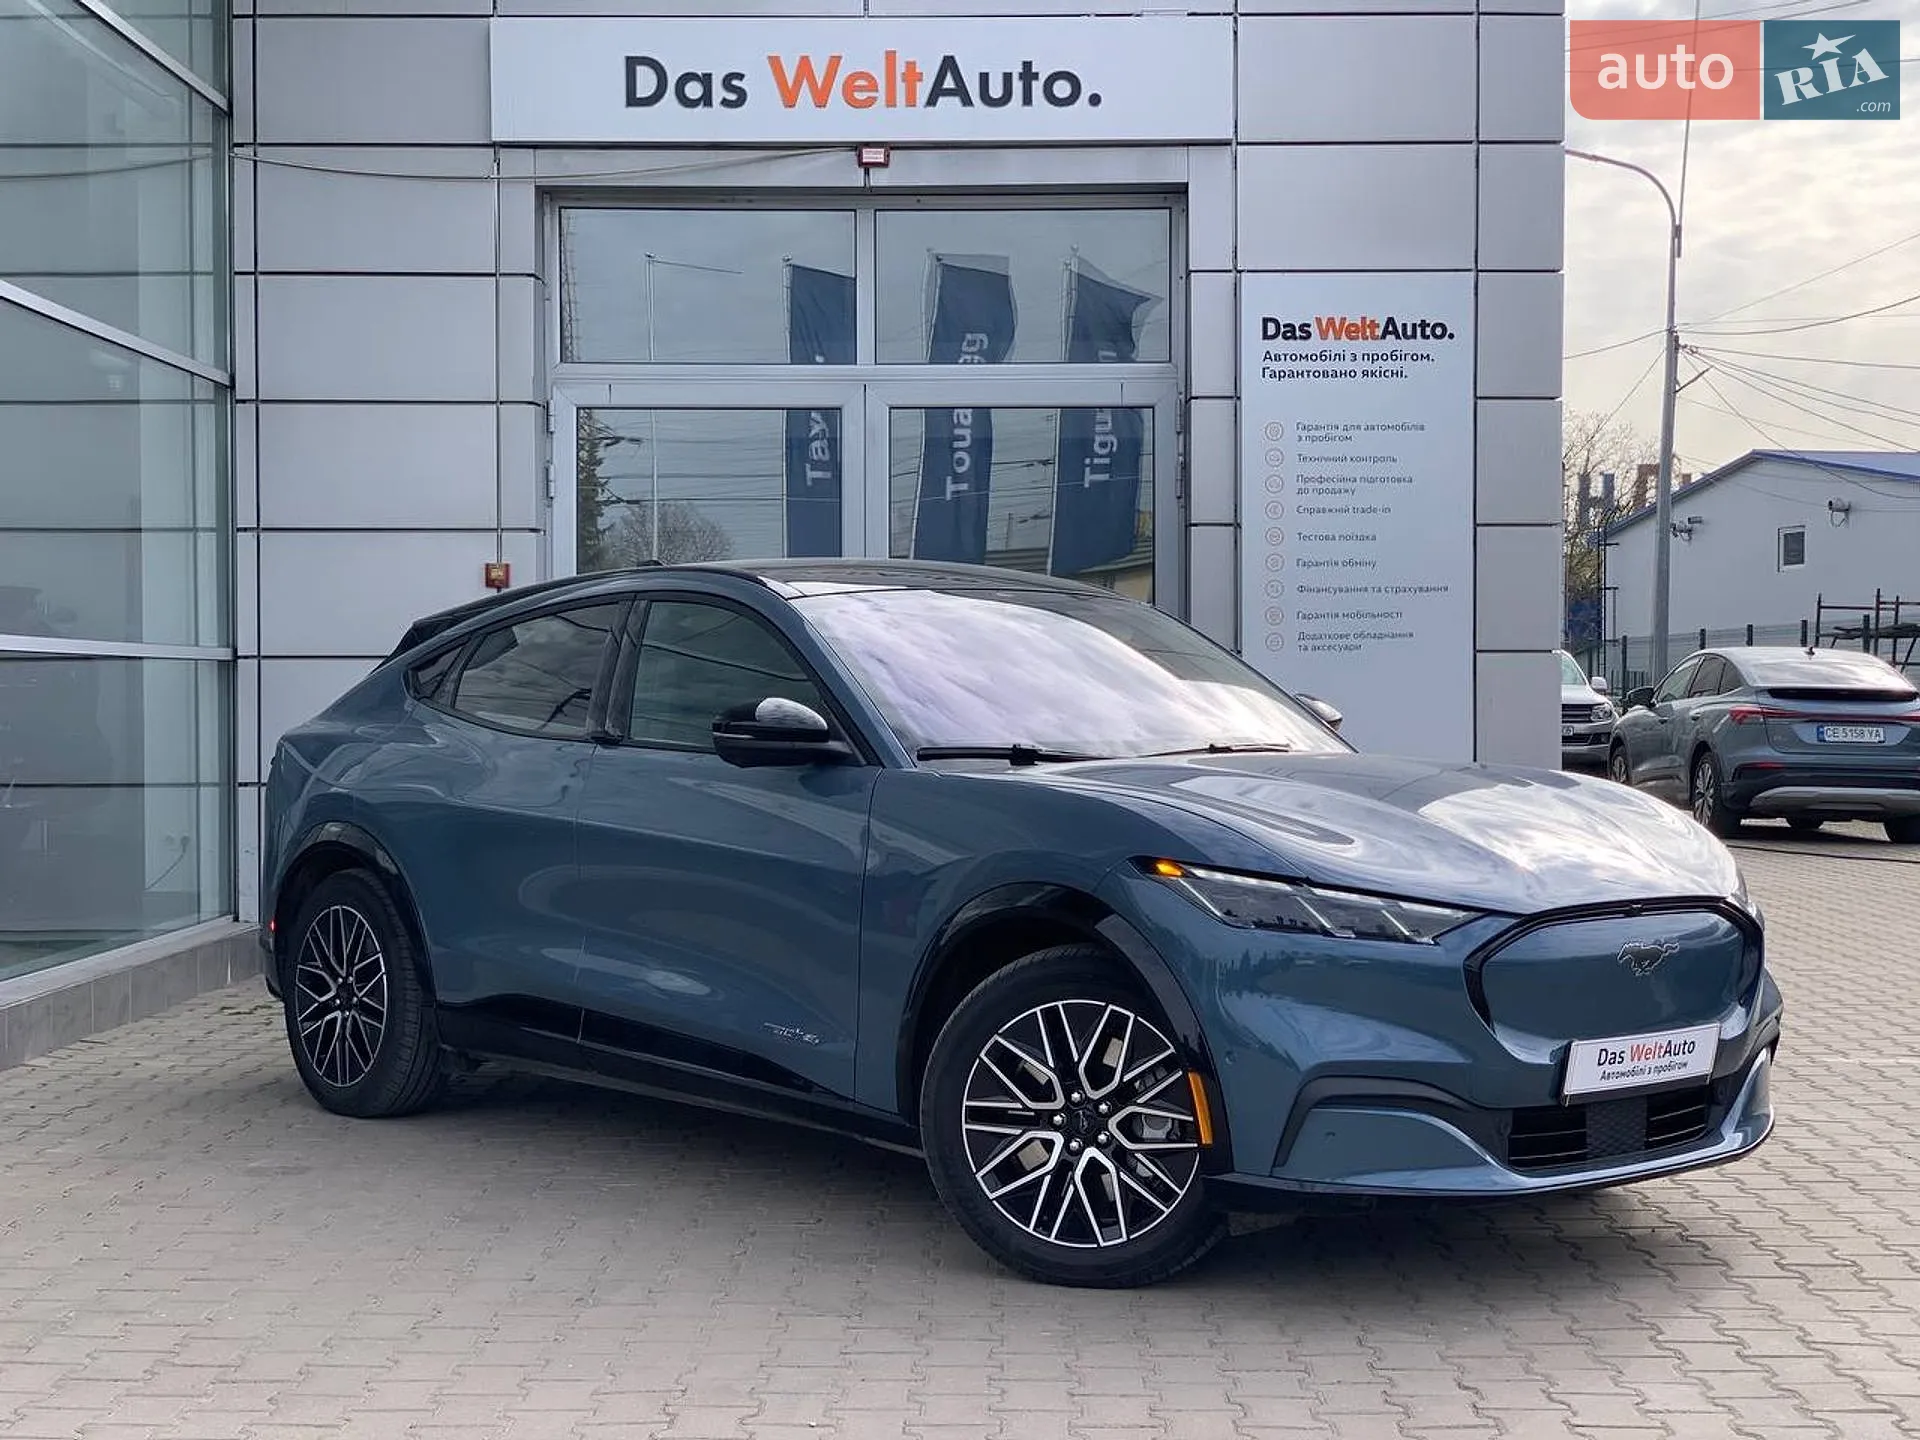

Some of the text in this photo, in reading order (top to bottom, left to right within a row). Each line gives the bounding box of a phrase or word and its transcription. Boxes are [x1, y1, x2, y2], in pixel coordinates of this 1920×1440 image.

[625, 50, 1102, 109] Das WeltAuto.
[1261, 316, 1455, 341] Das WeltAuto.
[1262, 350, 1435, 366] Автомобілі з пробігом.
[1262, 365, 1408, 380] Гарантовано якісні.
[1296, 421, 1425, 432] Гарантія для автомобілів
[1298, 432, 1353, 443] з пробігом
[1297, 453, 1398, 464] Технічний контроль
[1296, 474, 1413, 485] Професійна підготовка
[1296, 487, 1356, 496] до продажу
[1296, 504, 1392, 517] Справжній trade-in
[1297, 532, 1377, 542] Тестова поїздка
[1296, 558, 1377, 570] Гарантія обміну
[1296, 585, 1369, 595] Фінансування
[1384, 585, 1449, 595] страхування
[1296, 610, 1403, 620] Гарантія мобільності
[1297, 631, 1414, 641] Додаткове обладнання
[1298, 643, 1362, 653] та аксесуари
[1825, 727, 1839, 738] CE
[1597, 1039, 1696, 1066] Das WeltAuto
[1600, 1064, 1646, 1081] Автомобілі
[1653, 1060, 1688, 1076] пробігом
